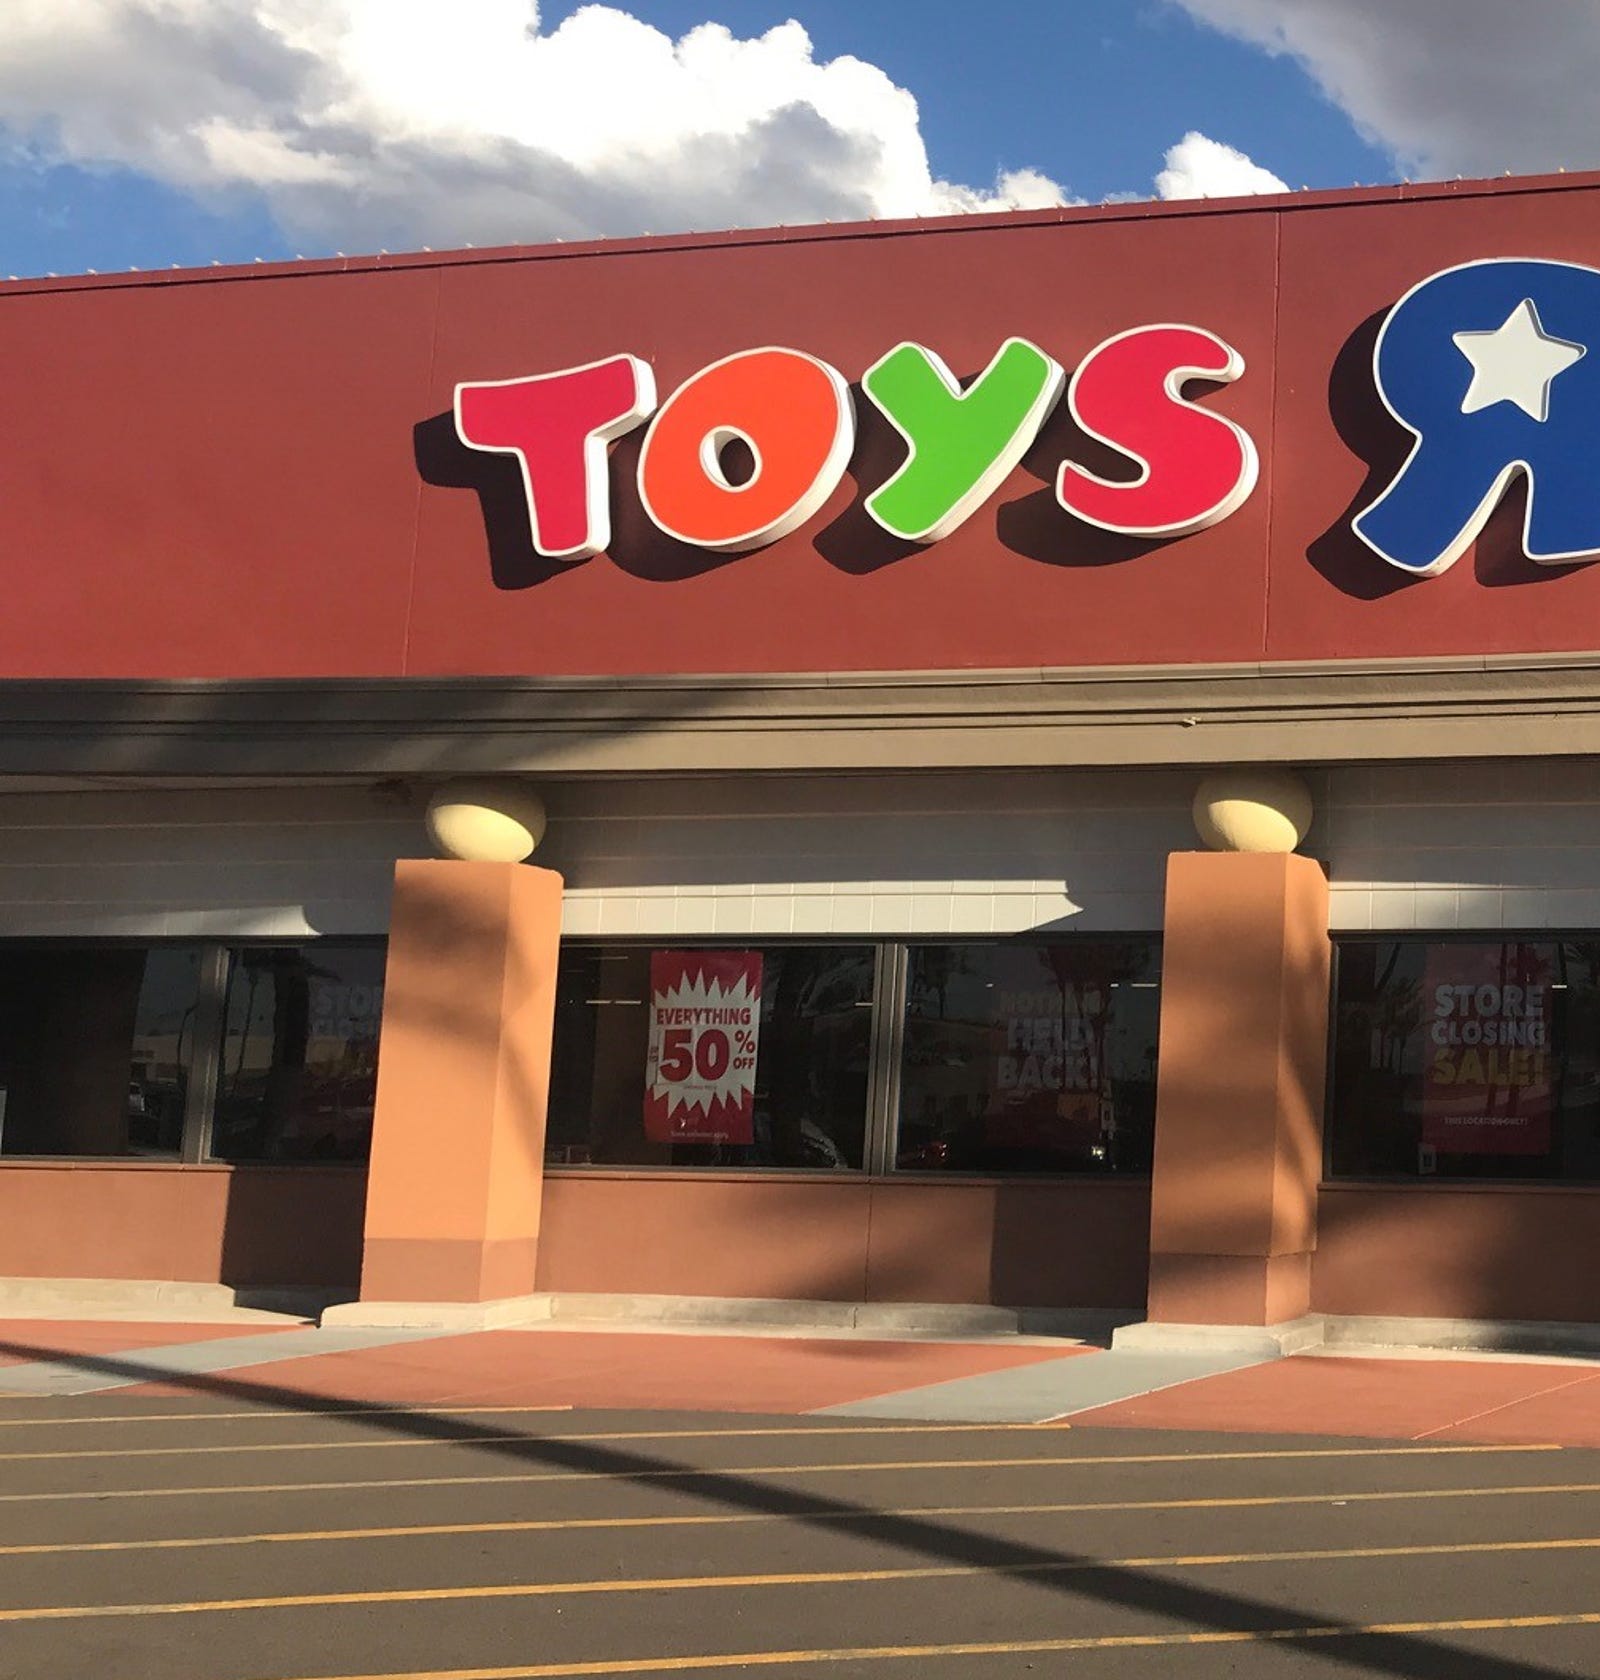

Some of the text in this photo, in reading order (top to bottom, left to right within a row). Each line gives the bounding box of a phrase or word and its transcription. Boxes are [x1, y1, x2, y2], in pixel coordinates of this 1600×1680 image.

[454, 323, 1260, 559] TOYS
[656, 1008, 751, 1025] EVERYTHING
[1434, 984, 1544, 1017] STORE
[1431, 1020, 1545, 1046] CLOSING
[733, 1058, 755, 1070] OFF
[997, 1056, 1098, 1089] BACK!
[1433, 1048, 1544, 1086] SALE!
